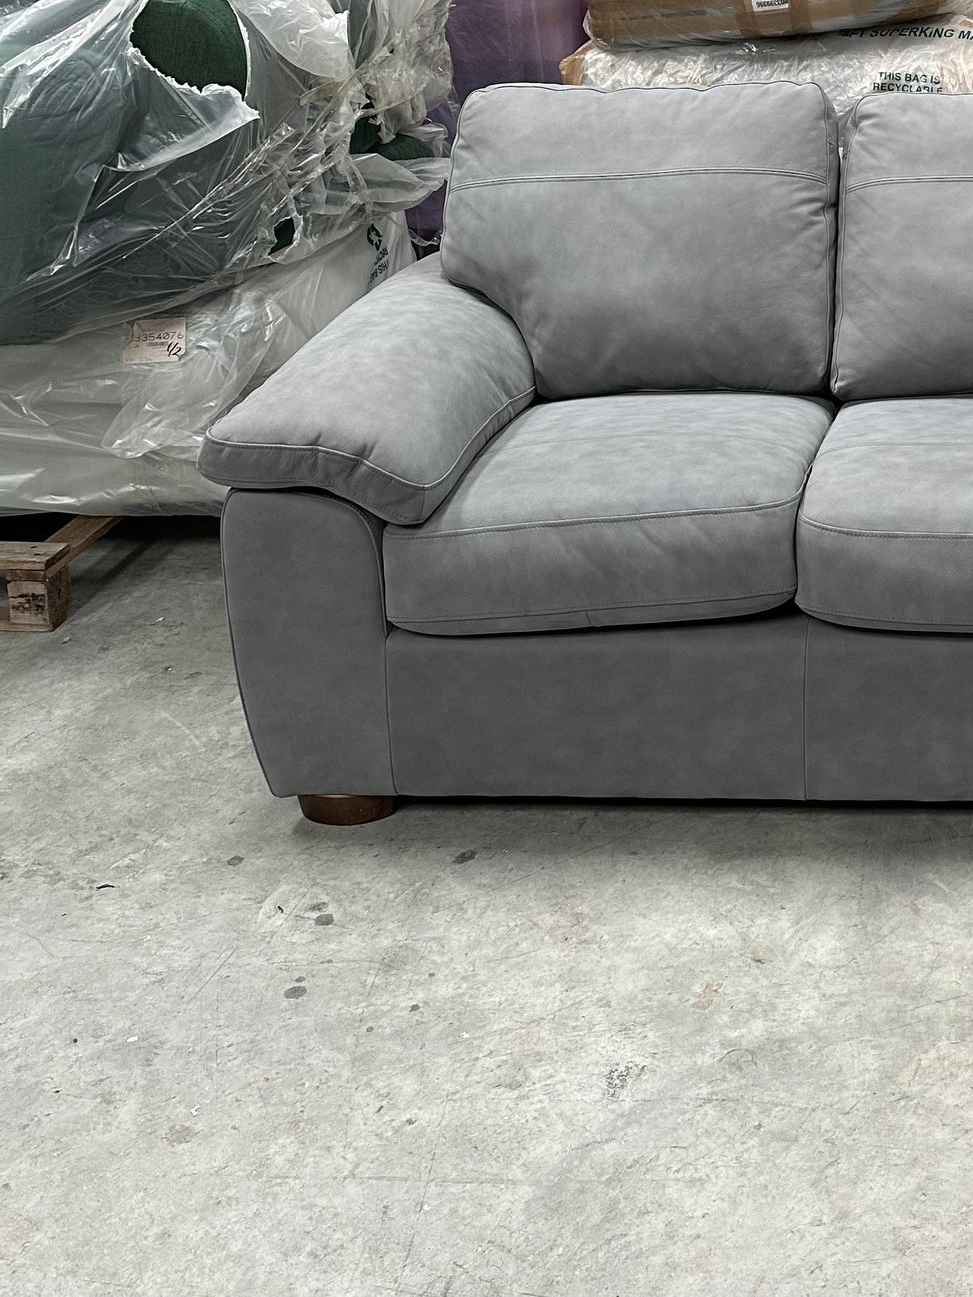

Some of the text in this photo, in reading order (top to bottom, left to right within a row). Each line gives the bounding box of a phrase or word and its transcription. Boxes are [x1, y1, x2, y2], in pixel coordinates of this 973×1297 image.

[878, 72, 940, 84] THIS BAG IS
[132, 331, 184, 343] 3354076
[167, 342, 181, 357] 1/2
